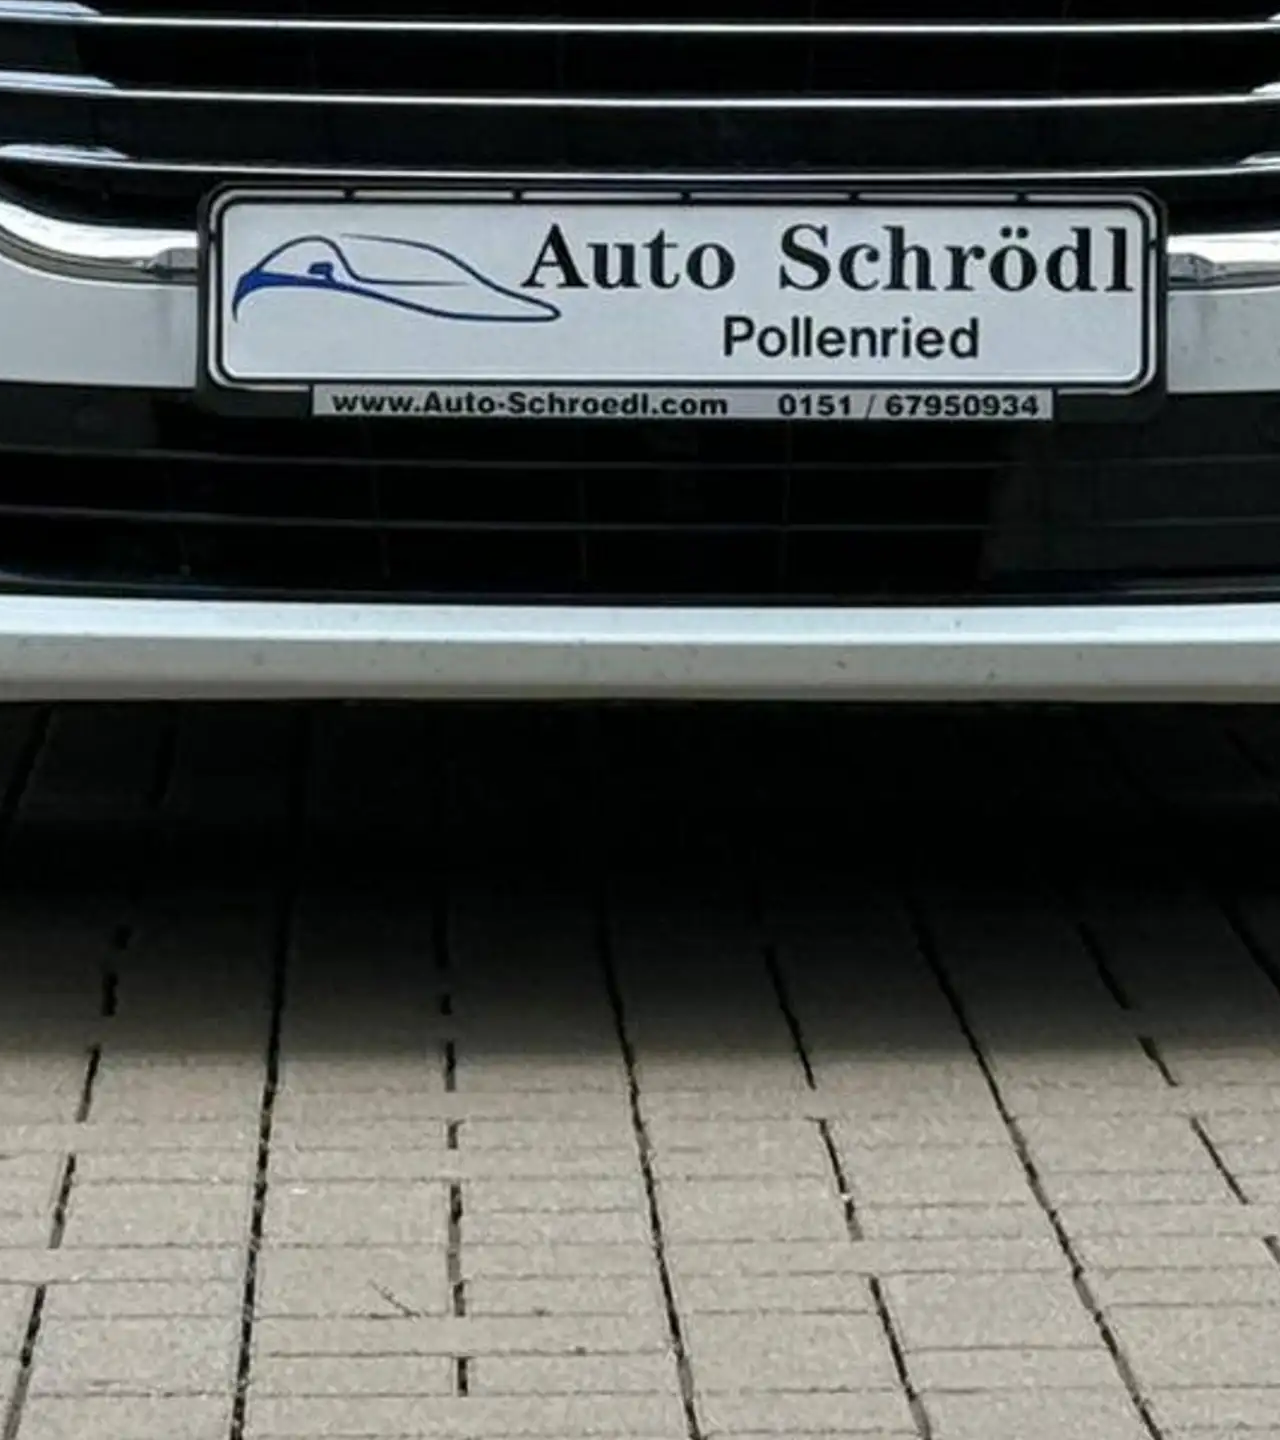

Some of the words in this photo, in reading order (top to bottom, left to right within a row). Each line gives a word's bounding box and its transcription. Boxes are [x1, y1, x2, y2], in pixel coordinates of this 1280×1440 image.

[520, 224, 736, 290] Auto
[778, 224, 1136, 294] Schrödl
[722, 314, 981, 360] Pollenried
[331, 389, 728, 418] www.Auto-Schroedl.com
[777, 393, 852, 419] 0151
[884, 393, 1042, 420] 67950934
